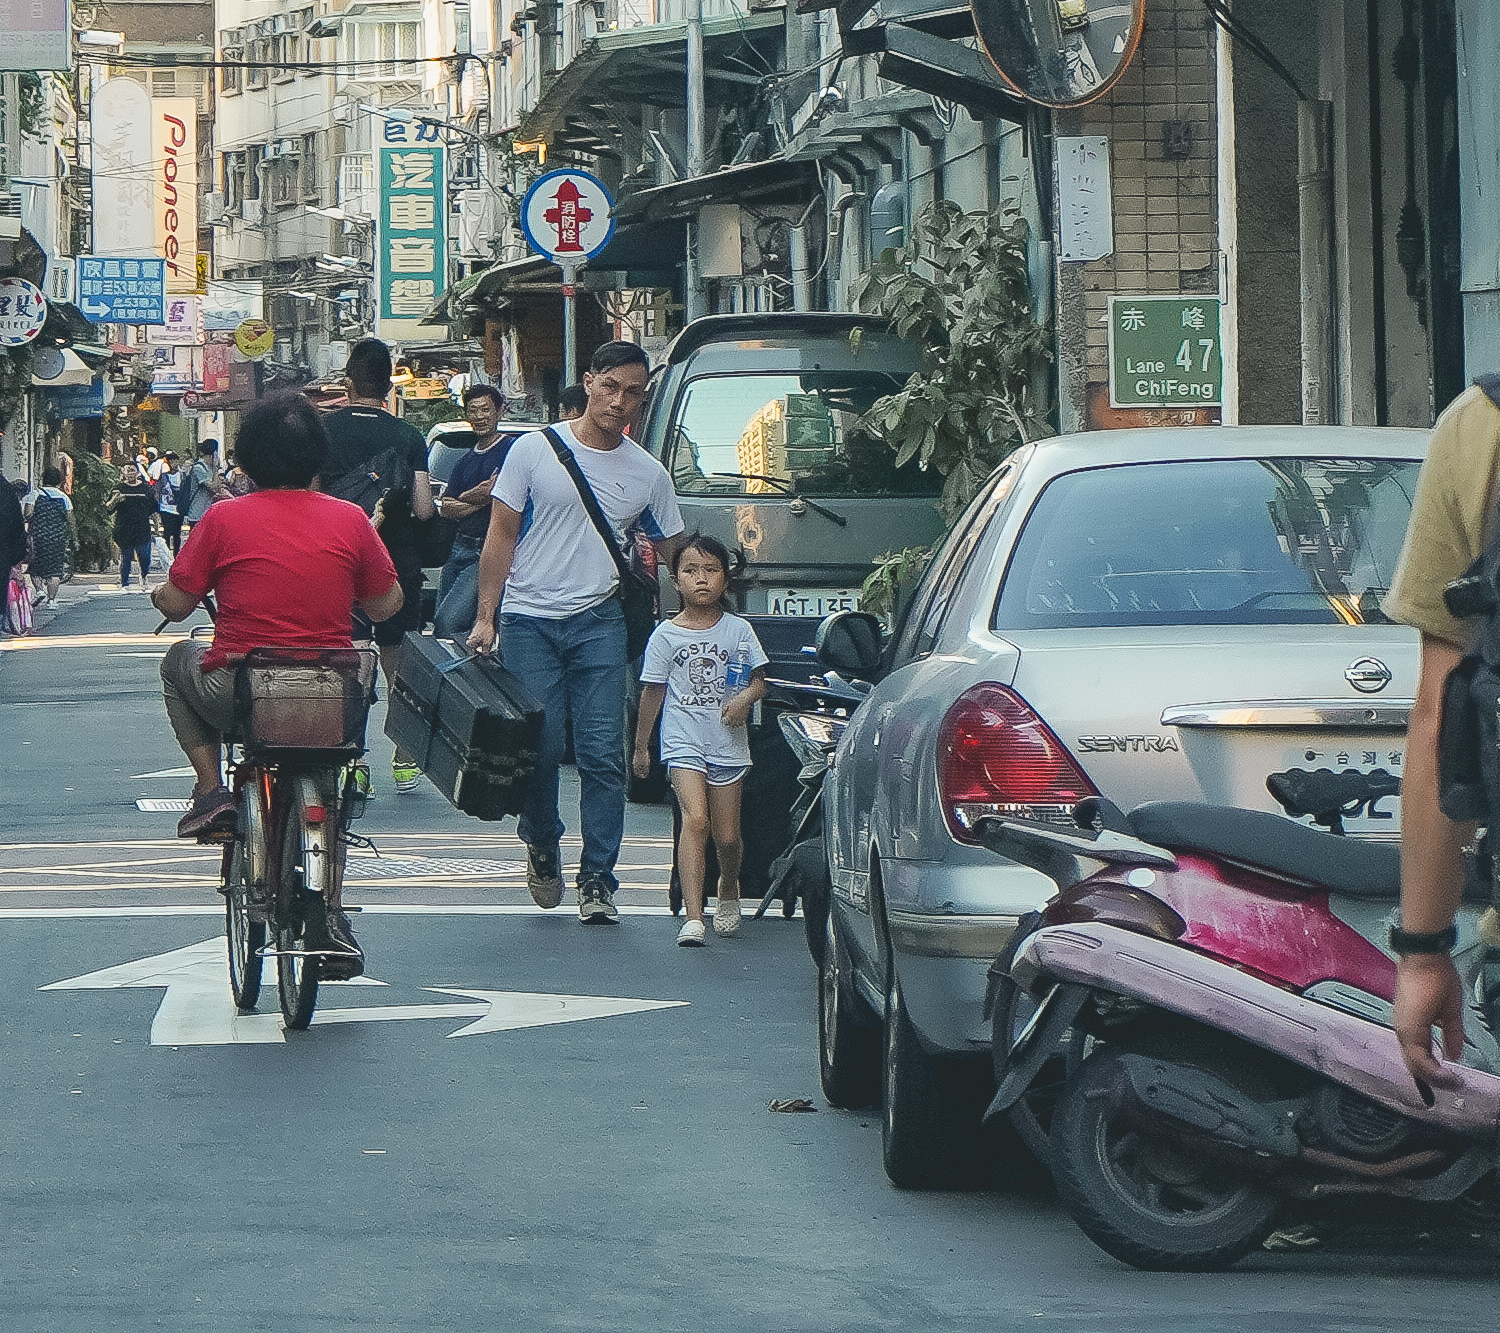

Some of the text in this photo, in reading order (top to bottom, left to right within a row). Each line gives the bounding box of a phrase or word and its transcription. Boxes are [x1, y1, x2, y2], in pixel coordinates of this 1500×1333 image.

[163, 113, 187, 278] Pioneer
[388, 152, 436, 315] 汽車音響
[561, 200, 577, 244] 消防栓
[1120, 306, 1206, 332] 赤峰
[1126, 338, 1214, 374] Lane 47
[1135, 379, 1214, 399] ChiFeng
[773, 597, 862, 616] AGT-135
[672, 641, 730, 668] ECSTAS
[1077, 734, 1180, 754] SENTRA
